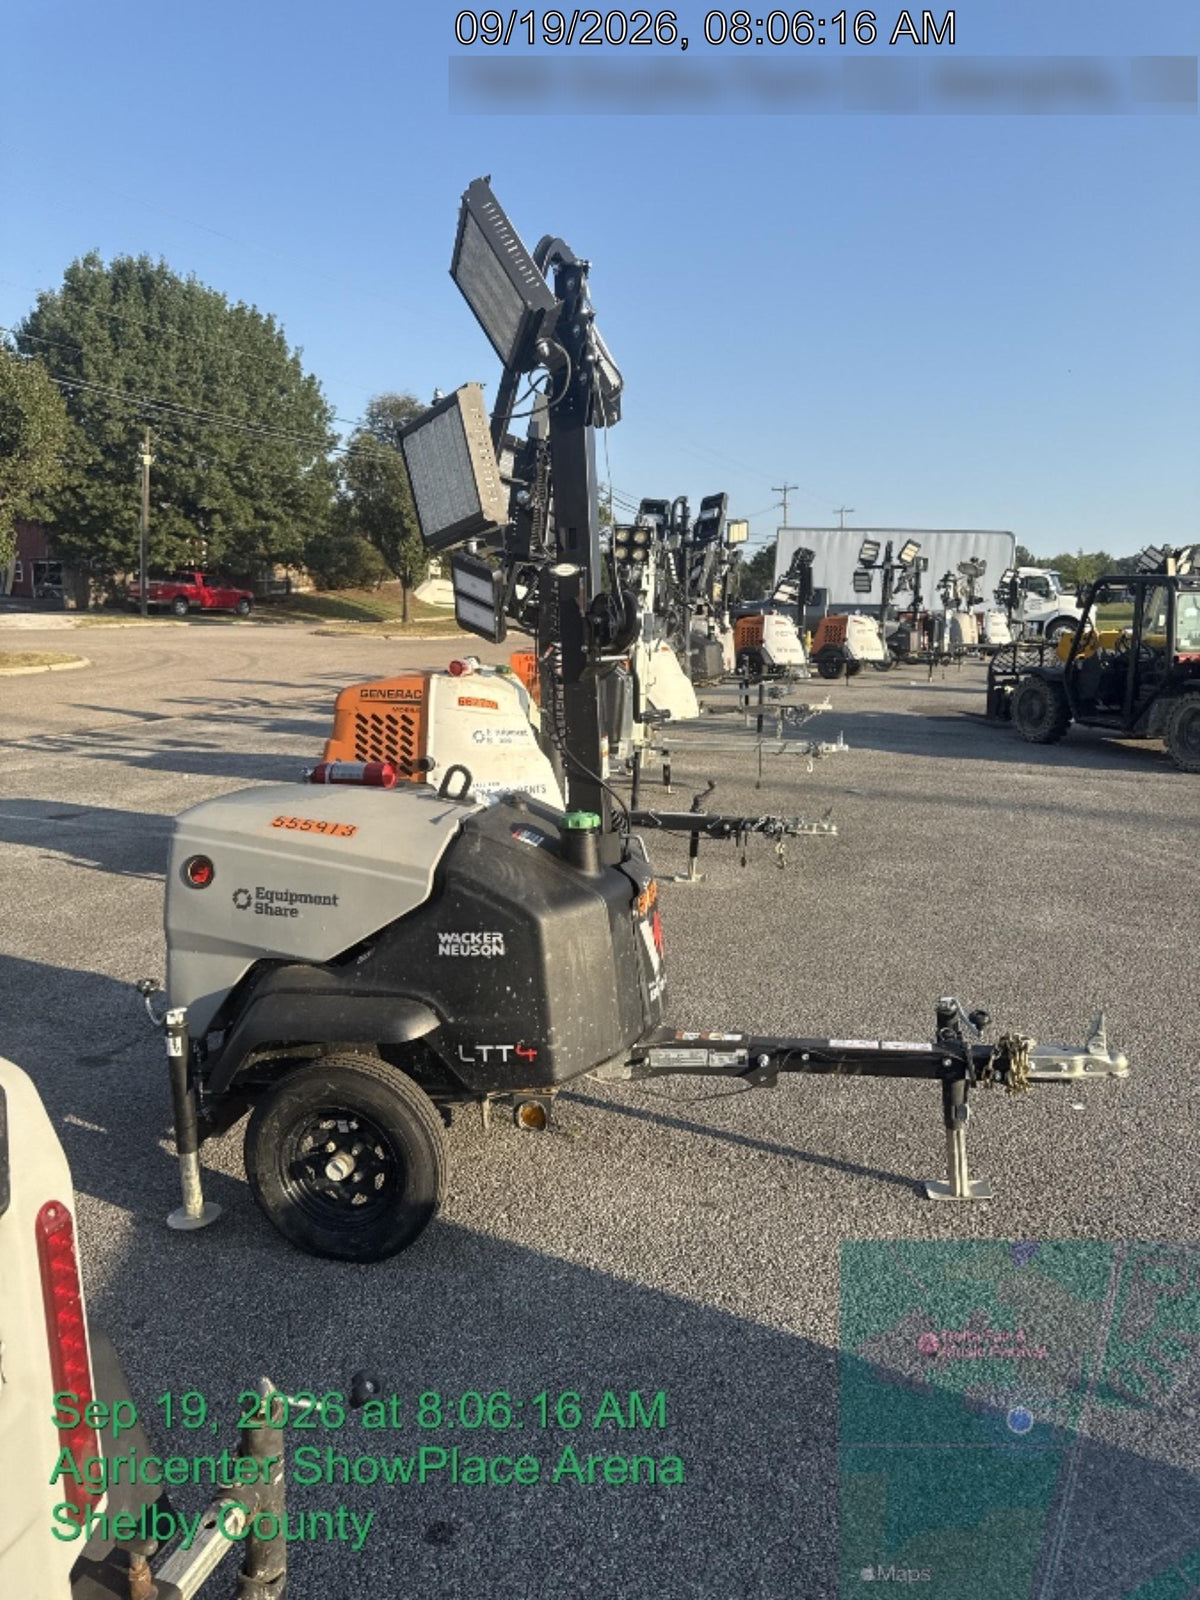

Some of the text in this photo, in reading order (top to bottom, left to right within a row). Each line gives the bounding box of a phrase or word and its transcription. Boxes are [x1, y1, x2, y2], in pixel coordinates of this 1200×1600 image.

[359, 689, 423, 700] GENERAC
[271, 816, 357, 837] 555913
[255, 886, 338, 907] Equipment
[254, 902, 299, 918] Share
[438, 932, 504, 944] WACKER
[438, 943, 505, 957] NEUSON
